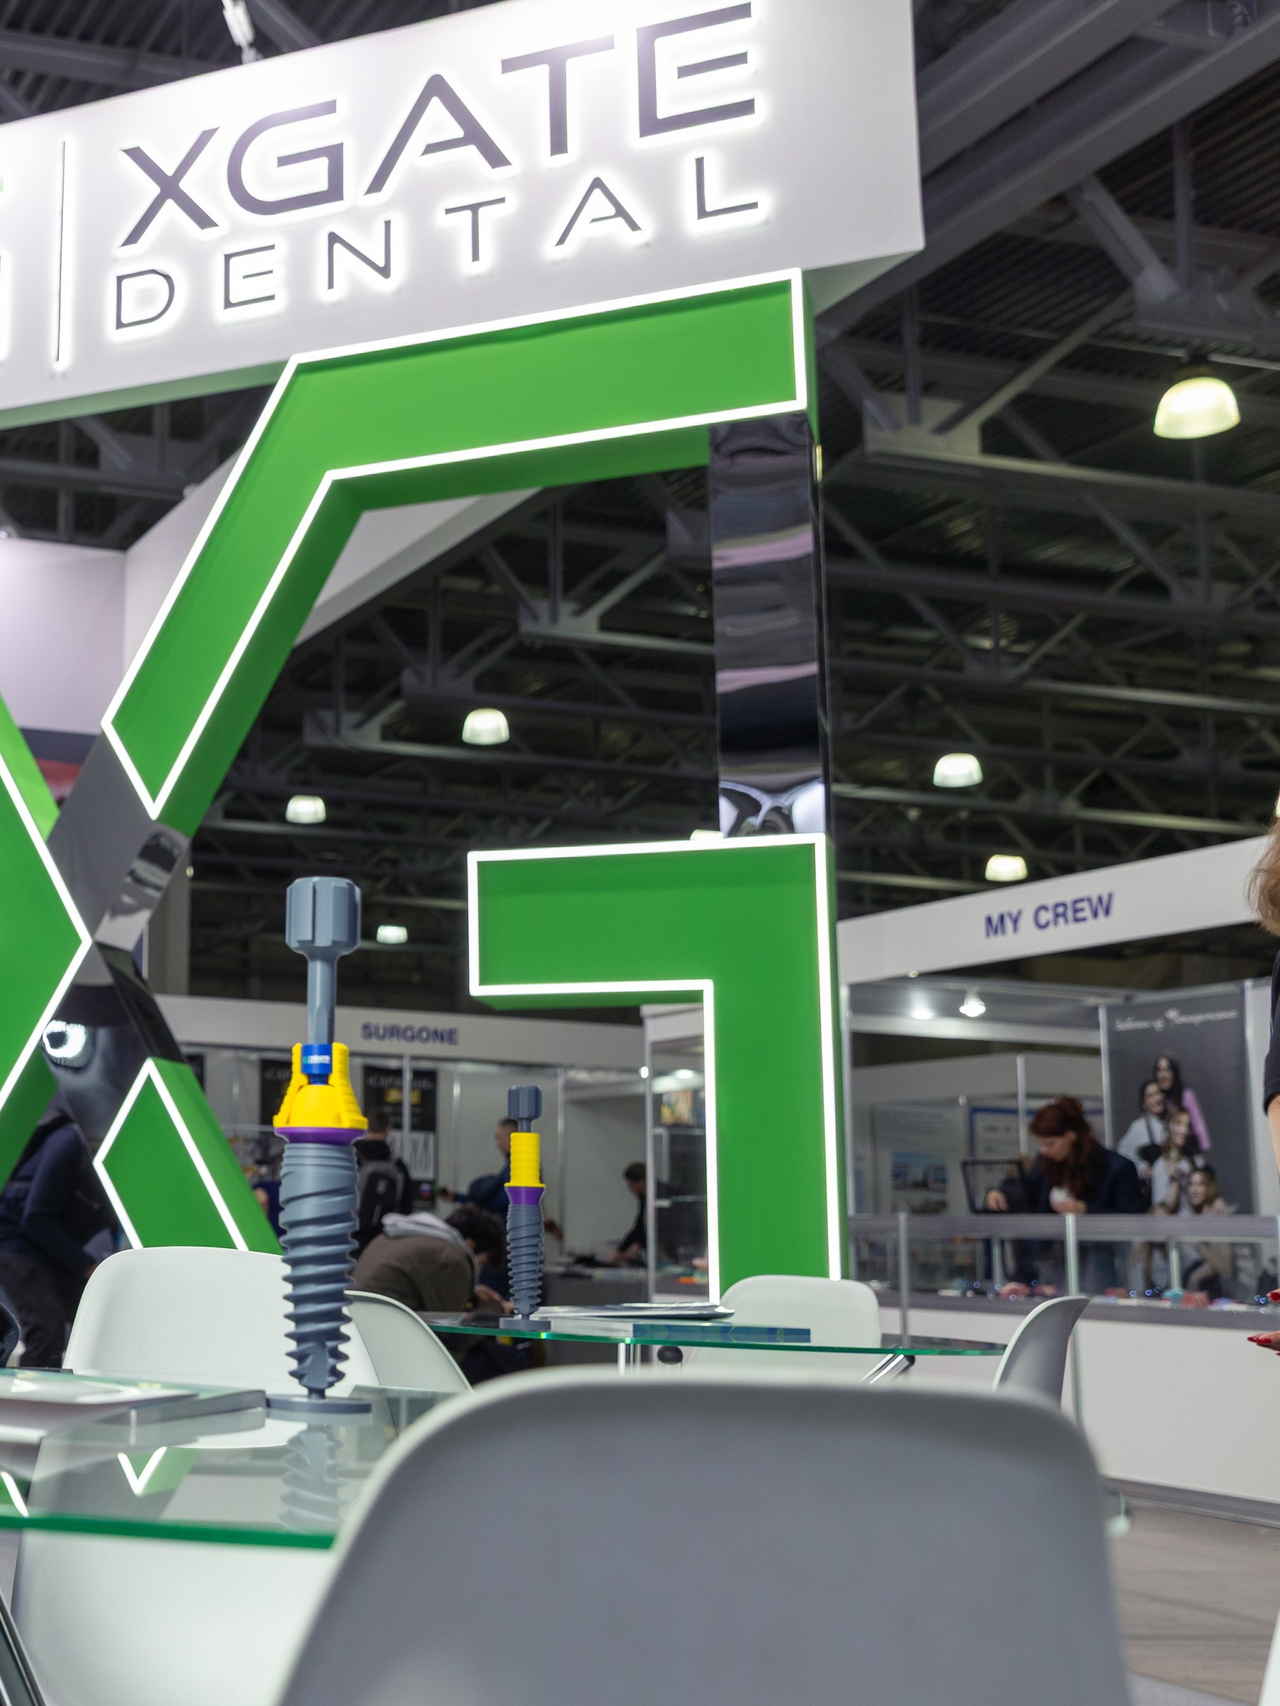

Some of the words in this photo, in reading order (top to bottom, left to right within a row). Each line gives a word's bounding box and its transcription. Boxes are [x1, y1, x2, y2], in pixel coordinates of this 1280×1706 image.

[120, 2, 756, 247] XGATE
[115, 156, 759, 331] DENTAL
[984, 910, 1024, 939] MY
[1032, 891, 1115, 930] CREW
[361, 1022, 460, 1046] SURGONE
